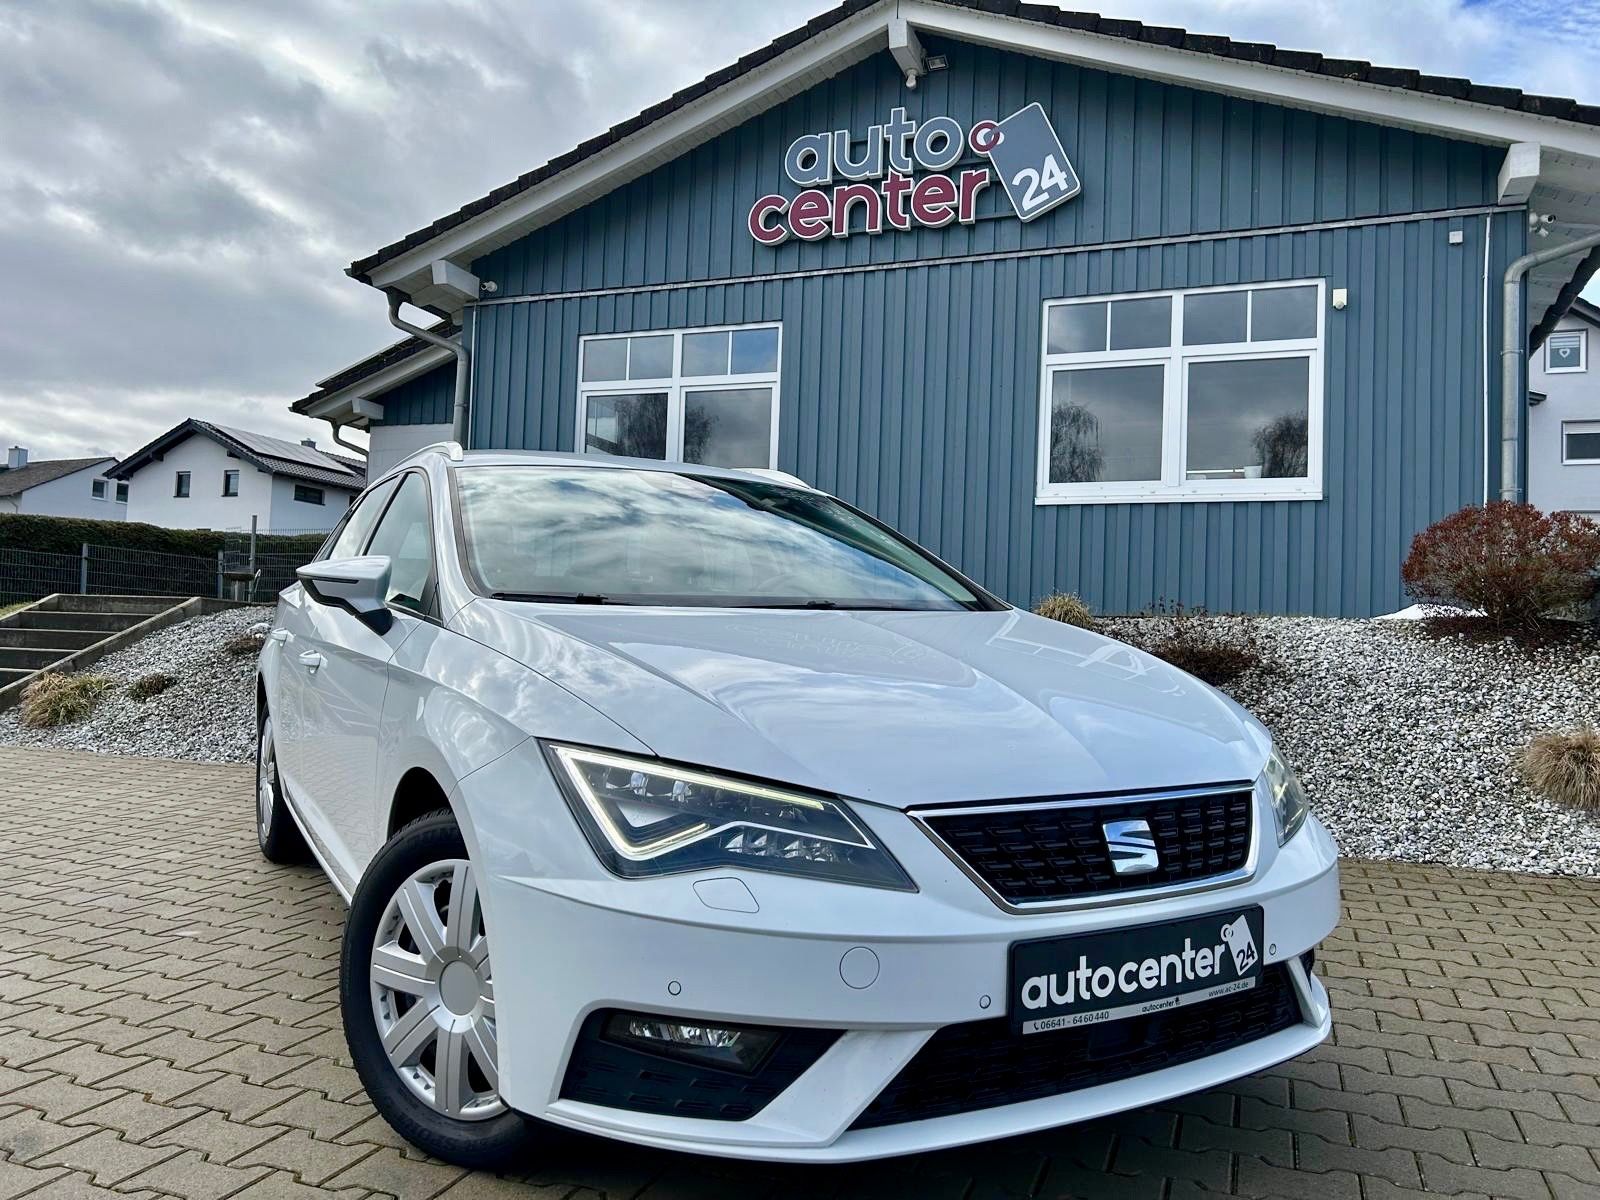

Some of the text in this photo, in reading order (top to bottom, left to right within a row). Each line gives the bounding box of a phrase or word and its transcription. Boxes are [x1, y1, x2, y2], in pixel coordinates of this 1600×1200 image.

[784, 107, 964, 186] auto
[748, 165, 990, 246] center
[1011, 153, 1068, 211] 24
[1236, 941, 1255, 971] 24
[1041, 1018, 1065, 1030] 06641
